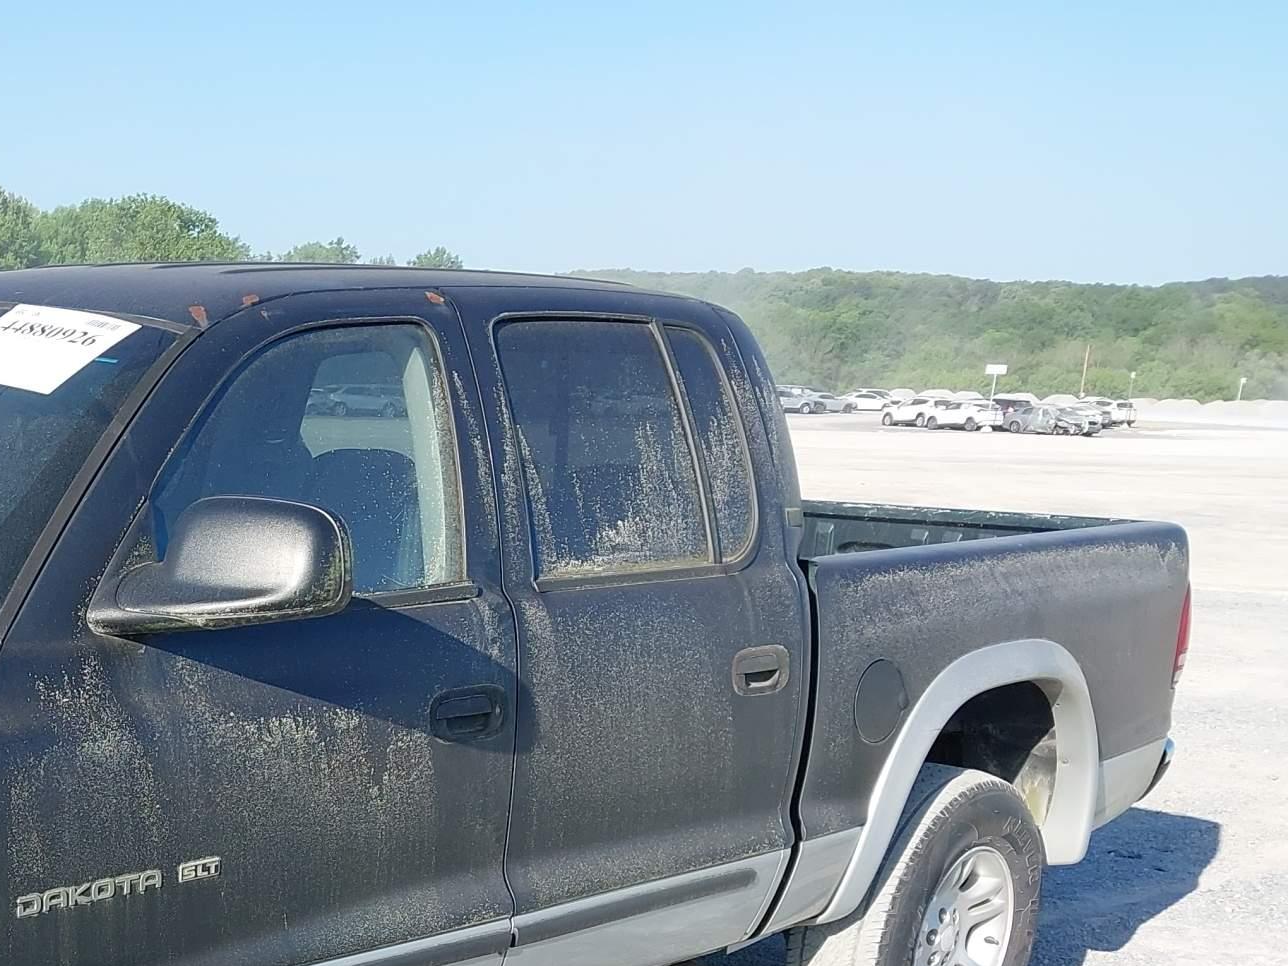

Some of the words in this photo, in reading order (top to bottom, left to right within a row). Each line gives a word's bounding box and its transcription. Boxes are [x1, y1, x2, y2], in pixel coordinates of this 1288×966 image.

[1, 320, 103, 347] 44880926
[16, 869, 162, 919] DAKOTA
[180, 859, 220, 881] SLT
